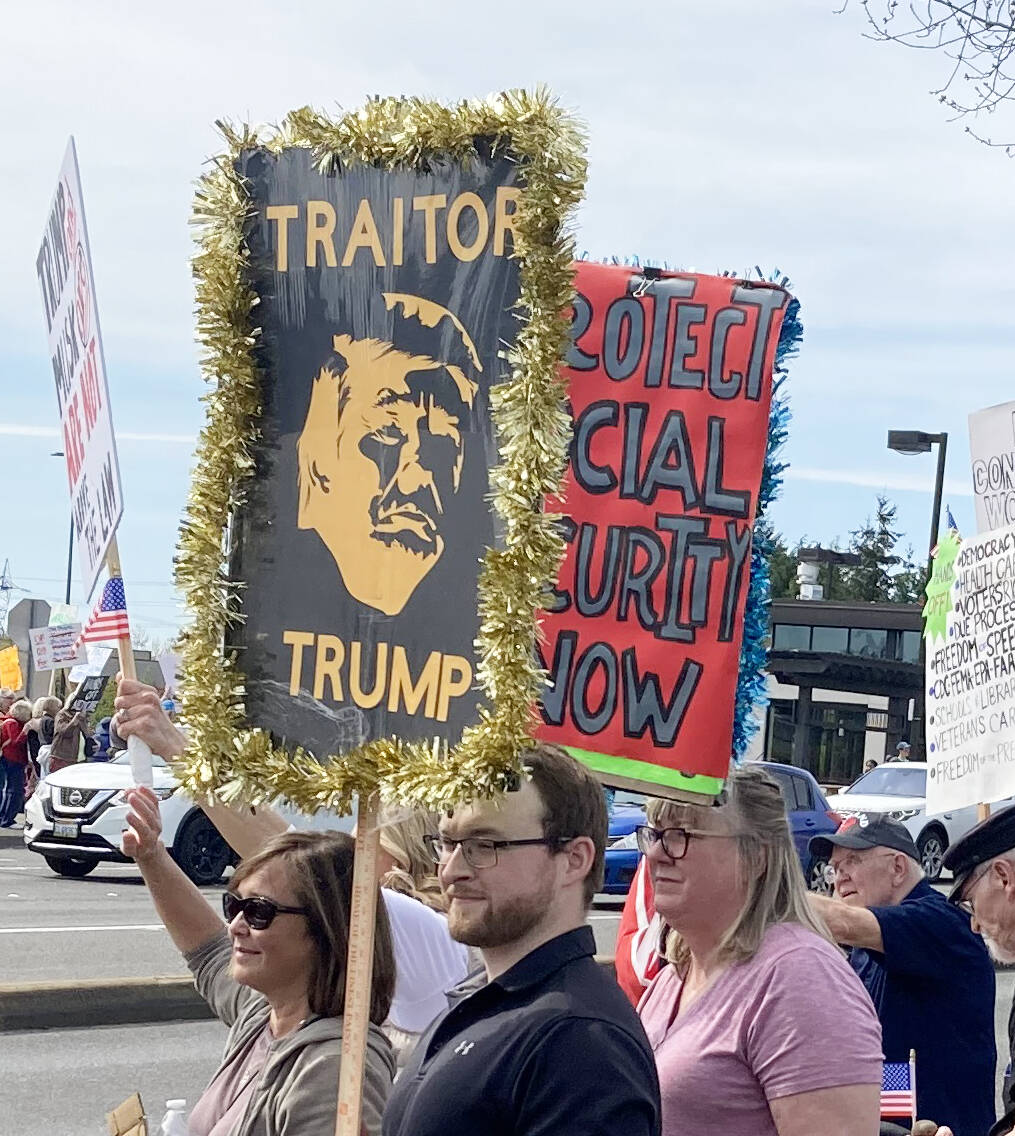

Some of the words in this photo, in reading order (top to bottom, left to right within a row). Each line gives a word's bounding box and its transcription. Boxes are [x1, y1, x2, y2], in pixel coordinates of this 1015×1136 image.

[36, 181, 70, 334] TRUMP
[266, 185, 523, 273] TRAITOR
[52, 301, 80, 419] MUSK
[567, 276, 791, 403] ROTECT
[80, 336, 101, 442] NOT
[97, 450, 117, 543] LAW
[570, 400, 752, 518] CIAL
[959, 582, 1003, 617] VOTERS
[960, 560, 993, 594] HEALTH
[935, 638, 978, 675] FREEDOM
[953, 617, 971, 640] DUE
[282, 630, 474, 723] TRUMP
[537, 630, 704, 749] NOW
[935, 716, 986, 752] VETERANS
[936, 752, 979, 785] FREEDOM
